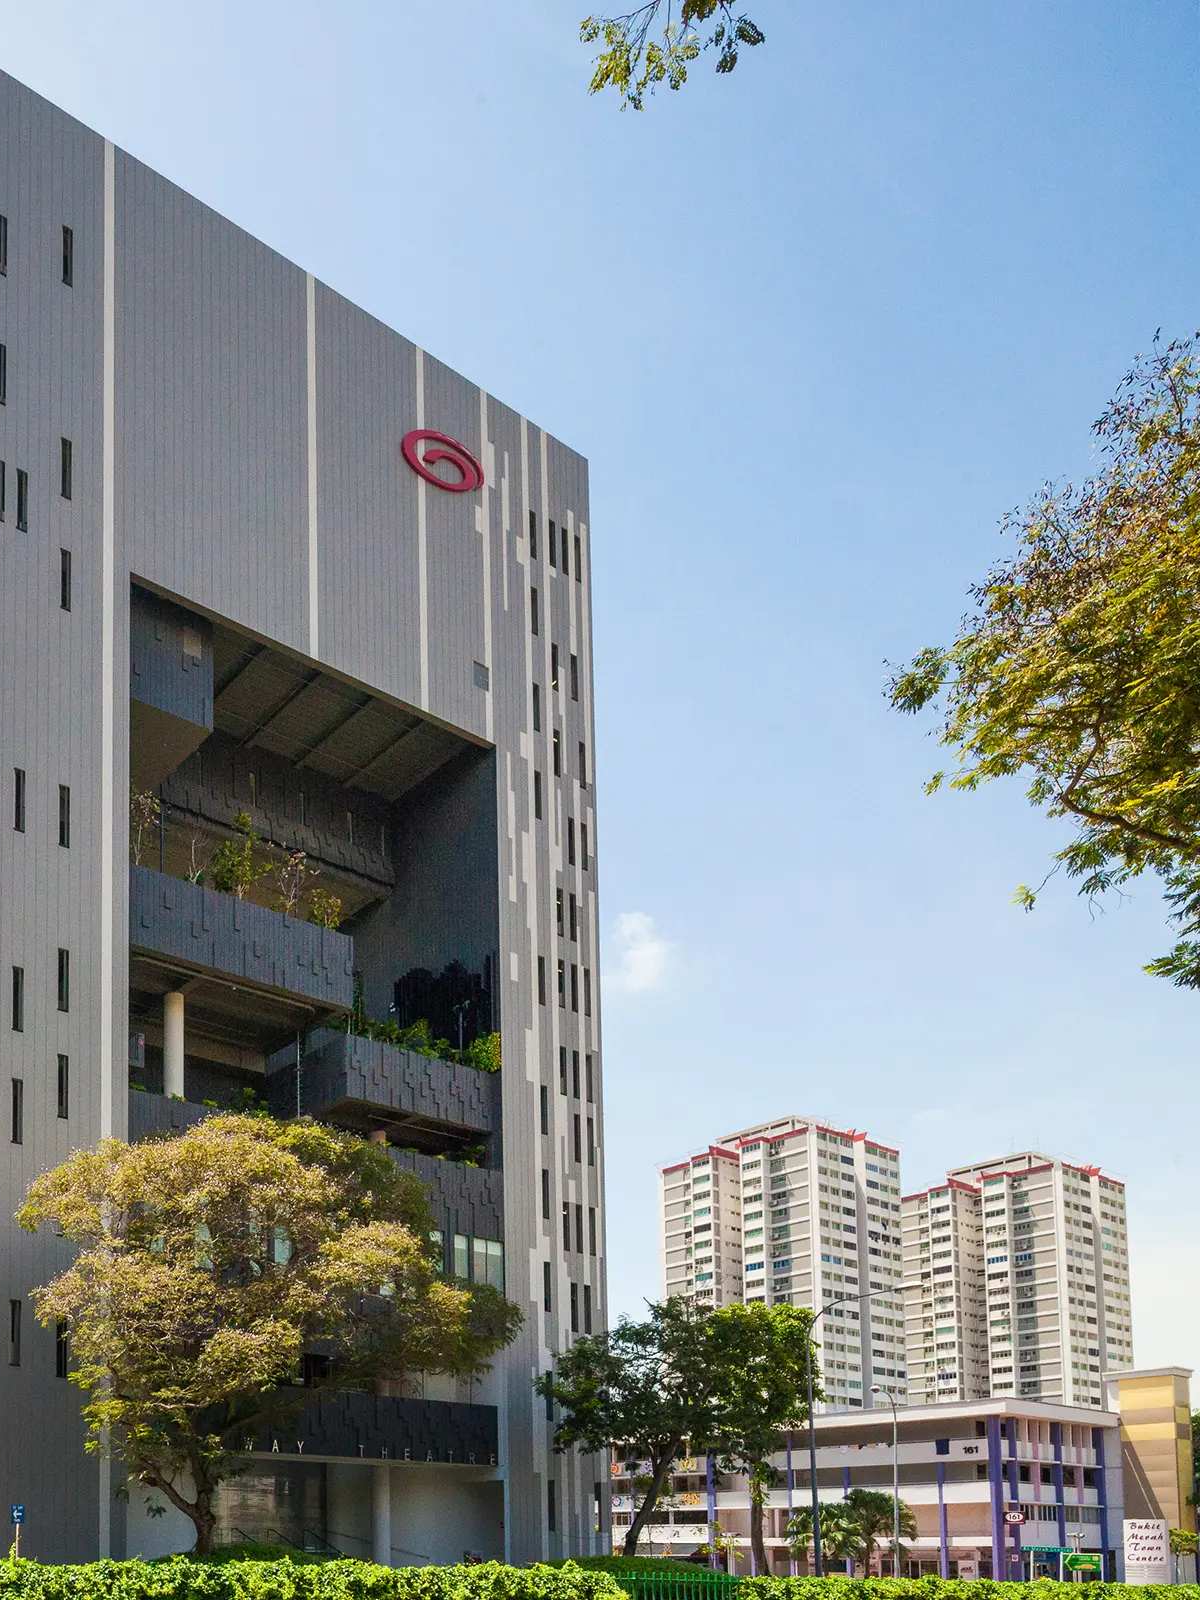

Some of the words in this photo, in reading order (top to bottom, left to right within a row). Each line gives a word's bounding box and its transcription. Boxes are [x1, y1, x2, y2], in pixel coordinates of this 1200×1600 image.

[359, 1444, 496, 1465] THEATRE
[963, 1446, 979, 1454] 161
[1128, 1522, 1161, 1530] Bukit
[1127, 1532, 1164, 1542] Merah
[1128, 1542, 1162, 1552] Town
[1127, 1553, 1164, 1562] Centre
